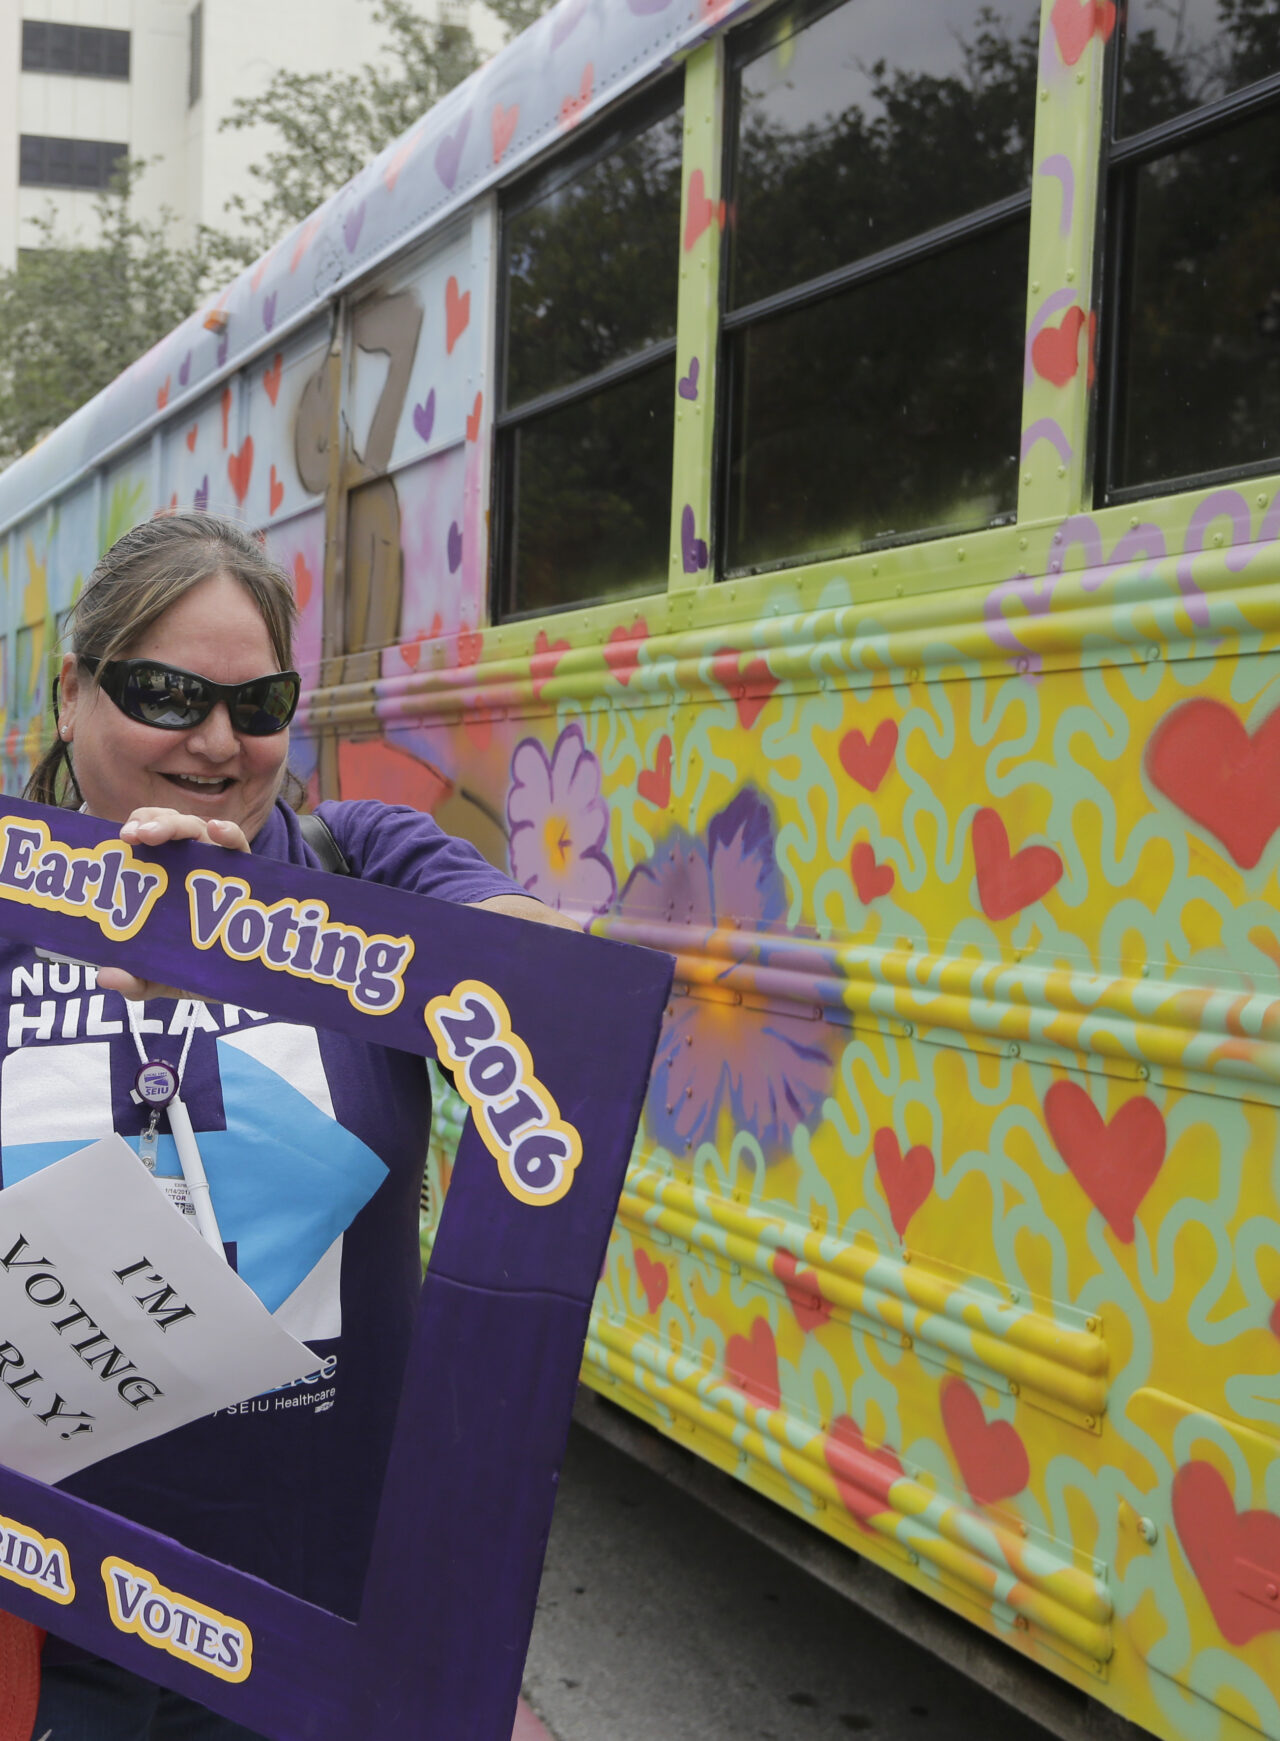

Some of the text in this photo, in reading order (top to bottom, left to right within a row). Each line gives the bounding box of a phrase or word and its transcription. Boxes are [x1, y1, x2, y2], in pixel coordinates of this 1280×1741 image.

[8, 994, 269, 1047] HILLA
[191, 877, 408, 1006] Voting
[439, 997, 569, 1189] 2016
[145, 1086, 169, 1096] SEIU
[111, 1255, 197, 1334] I'M
[226, 1399, 270, 1415] SEIU
[274, 1387, 337, 1411] Healthcare
[113, 1572, 241, 1669] VOTES
